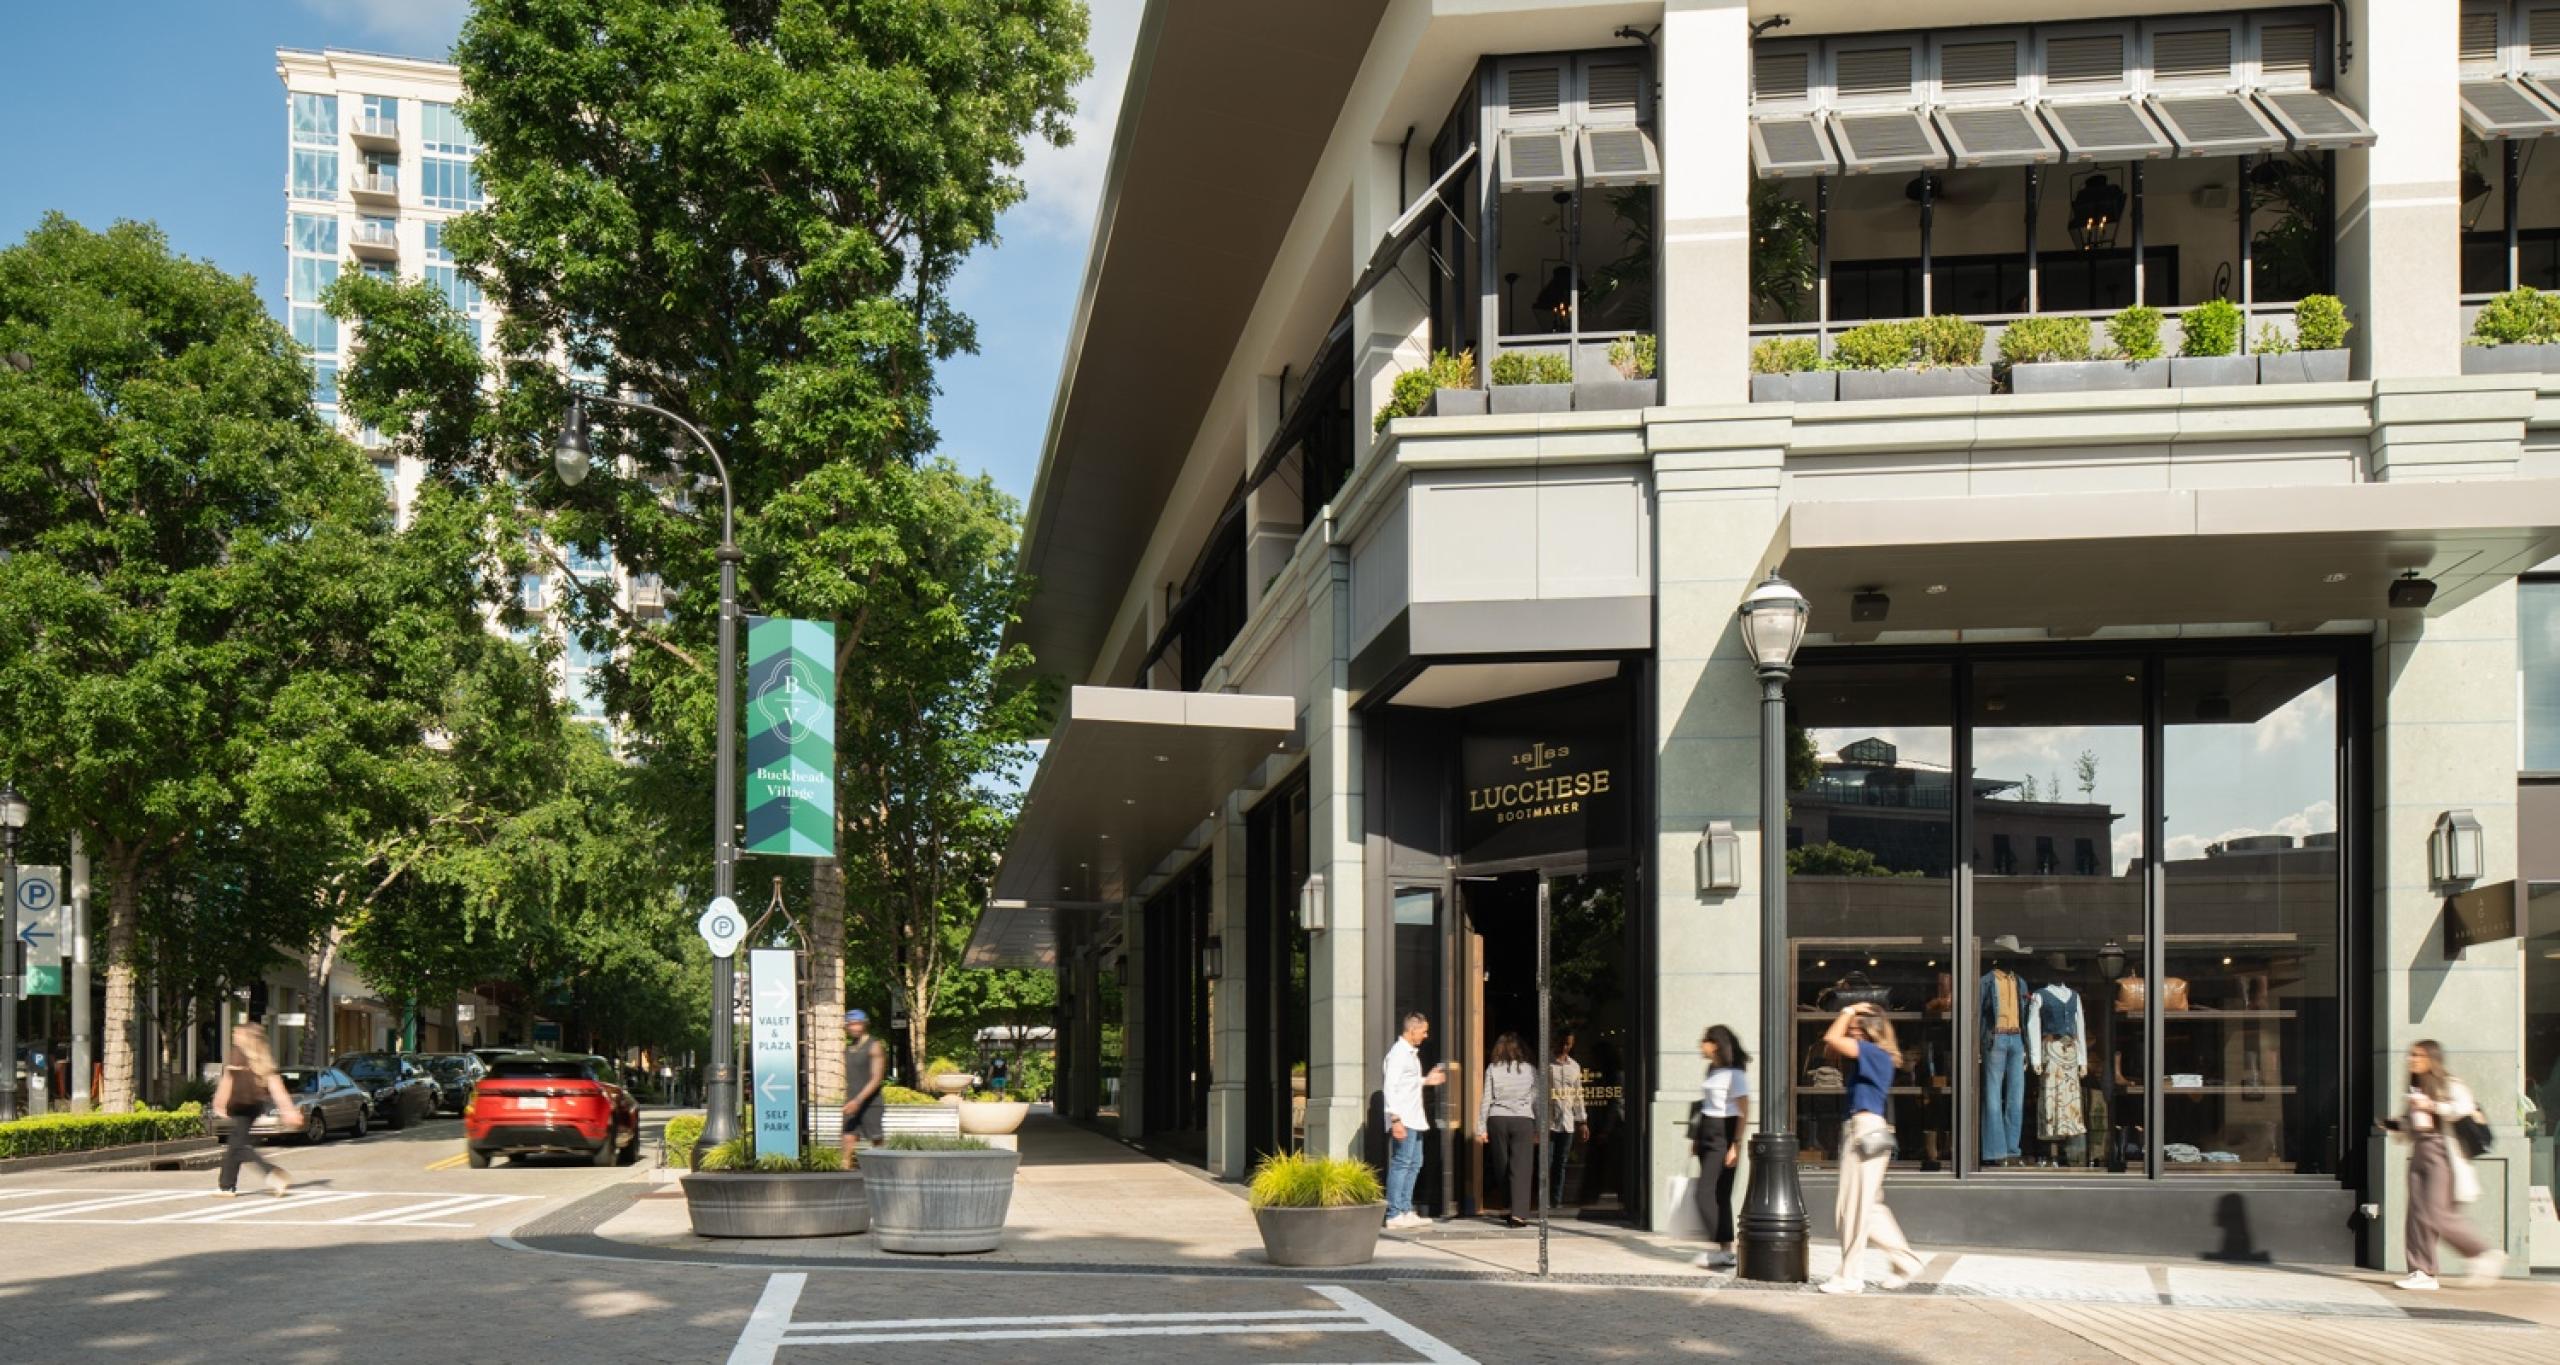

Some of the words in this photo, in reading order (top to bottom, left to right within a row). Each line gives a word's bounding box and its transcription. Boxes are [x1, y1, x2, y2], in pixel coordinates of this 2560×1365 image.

[783, 675, 799, 694] B
[783, 707, 799, 725] V
[757, 767, 825, 784] Buckhead
[767, 784, 815, 800] Village
[1469, 770, 1610, 811] LUCCHESE
[1497, 801, 1580, 823] BOOTMAKER
[28, 884, 46, 904] P
[758, 1016, 791, 1026] VALET
[770, 1028, 779, 1038] &
[758, 1041, 792, 1051] PLAZA
[34, 1053, 44, 1066] P
[1551, 1086, 1622, 1100] LUCCHESE
[764, 1110, 788, 1120] SELF
[763, 1122, 791, 1132] PARK
